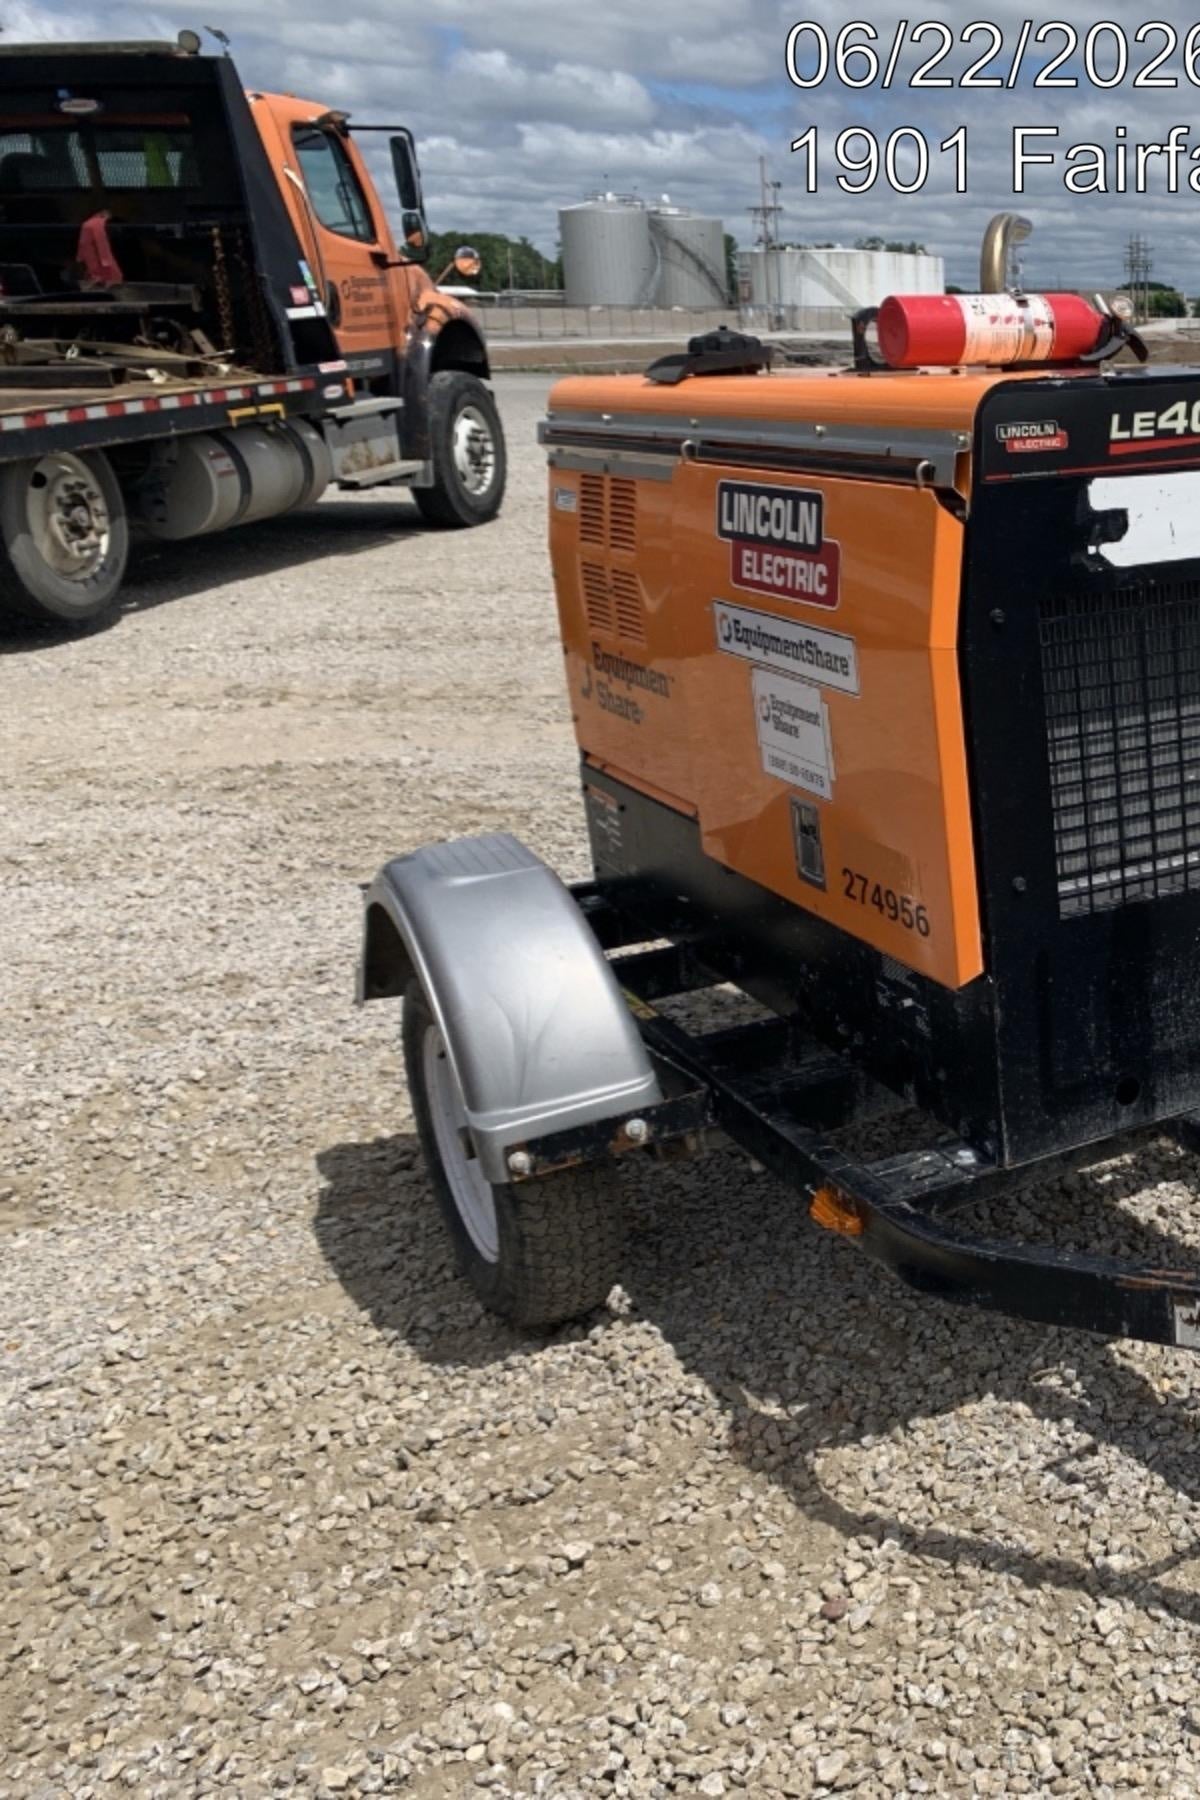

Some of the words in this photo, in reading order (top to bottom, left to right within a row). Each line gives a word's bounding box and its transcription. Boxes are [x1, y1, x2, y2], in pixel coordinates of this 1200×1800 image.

[1000, 423, 1056, 438] LINCOLN
[1013, 436, 1062, 450] ELECTRIC
[721, 490, 819, 546] LINCOLN
[740, 549, 829, 597] ELECTRIC
[732, 618, 851, 677] EquipmentShare
[596, 679, 643, 725] Share
[841, 866, 931, 938] 274956
